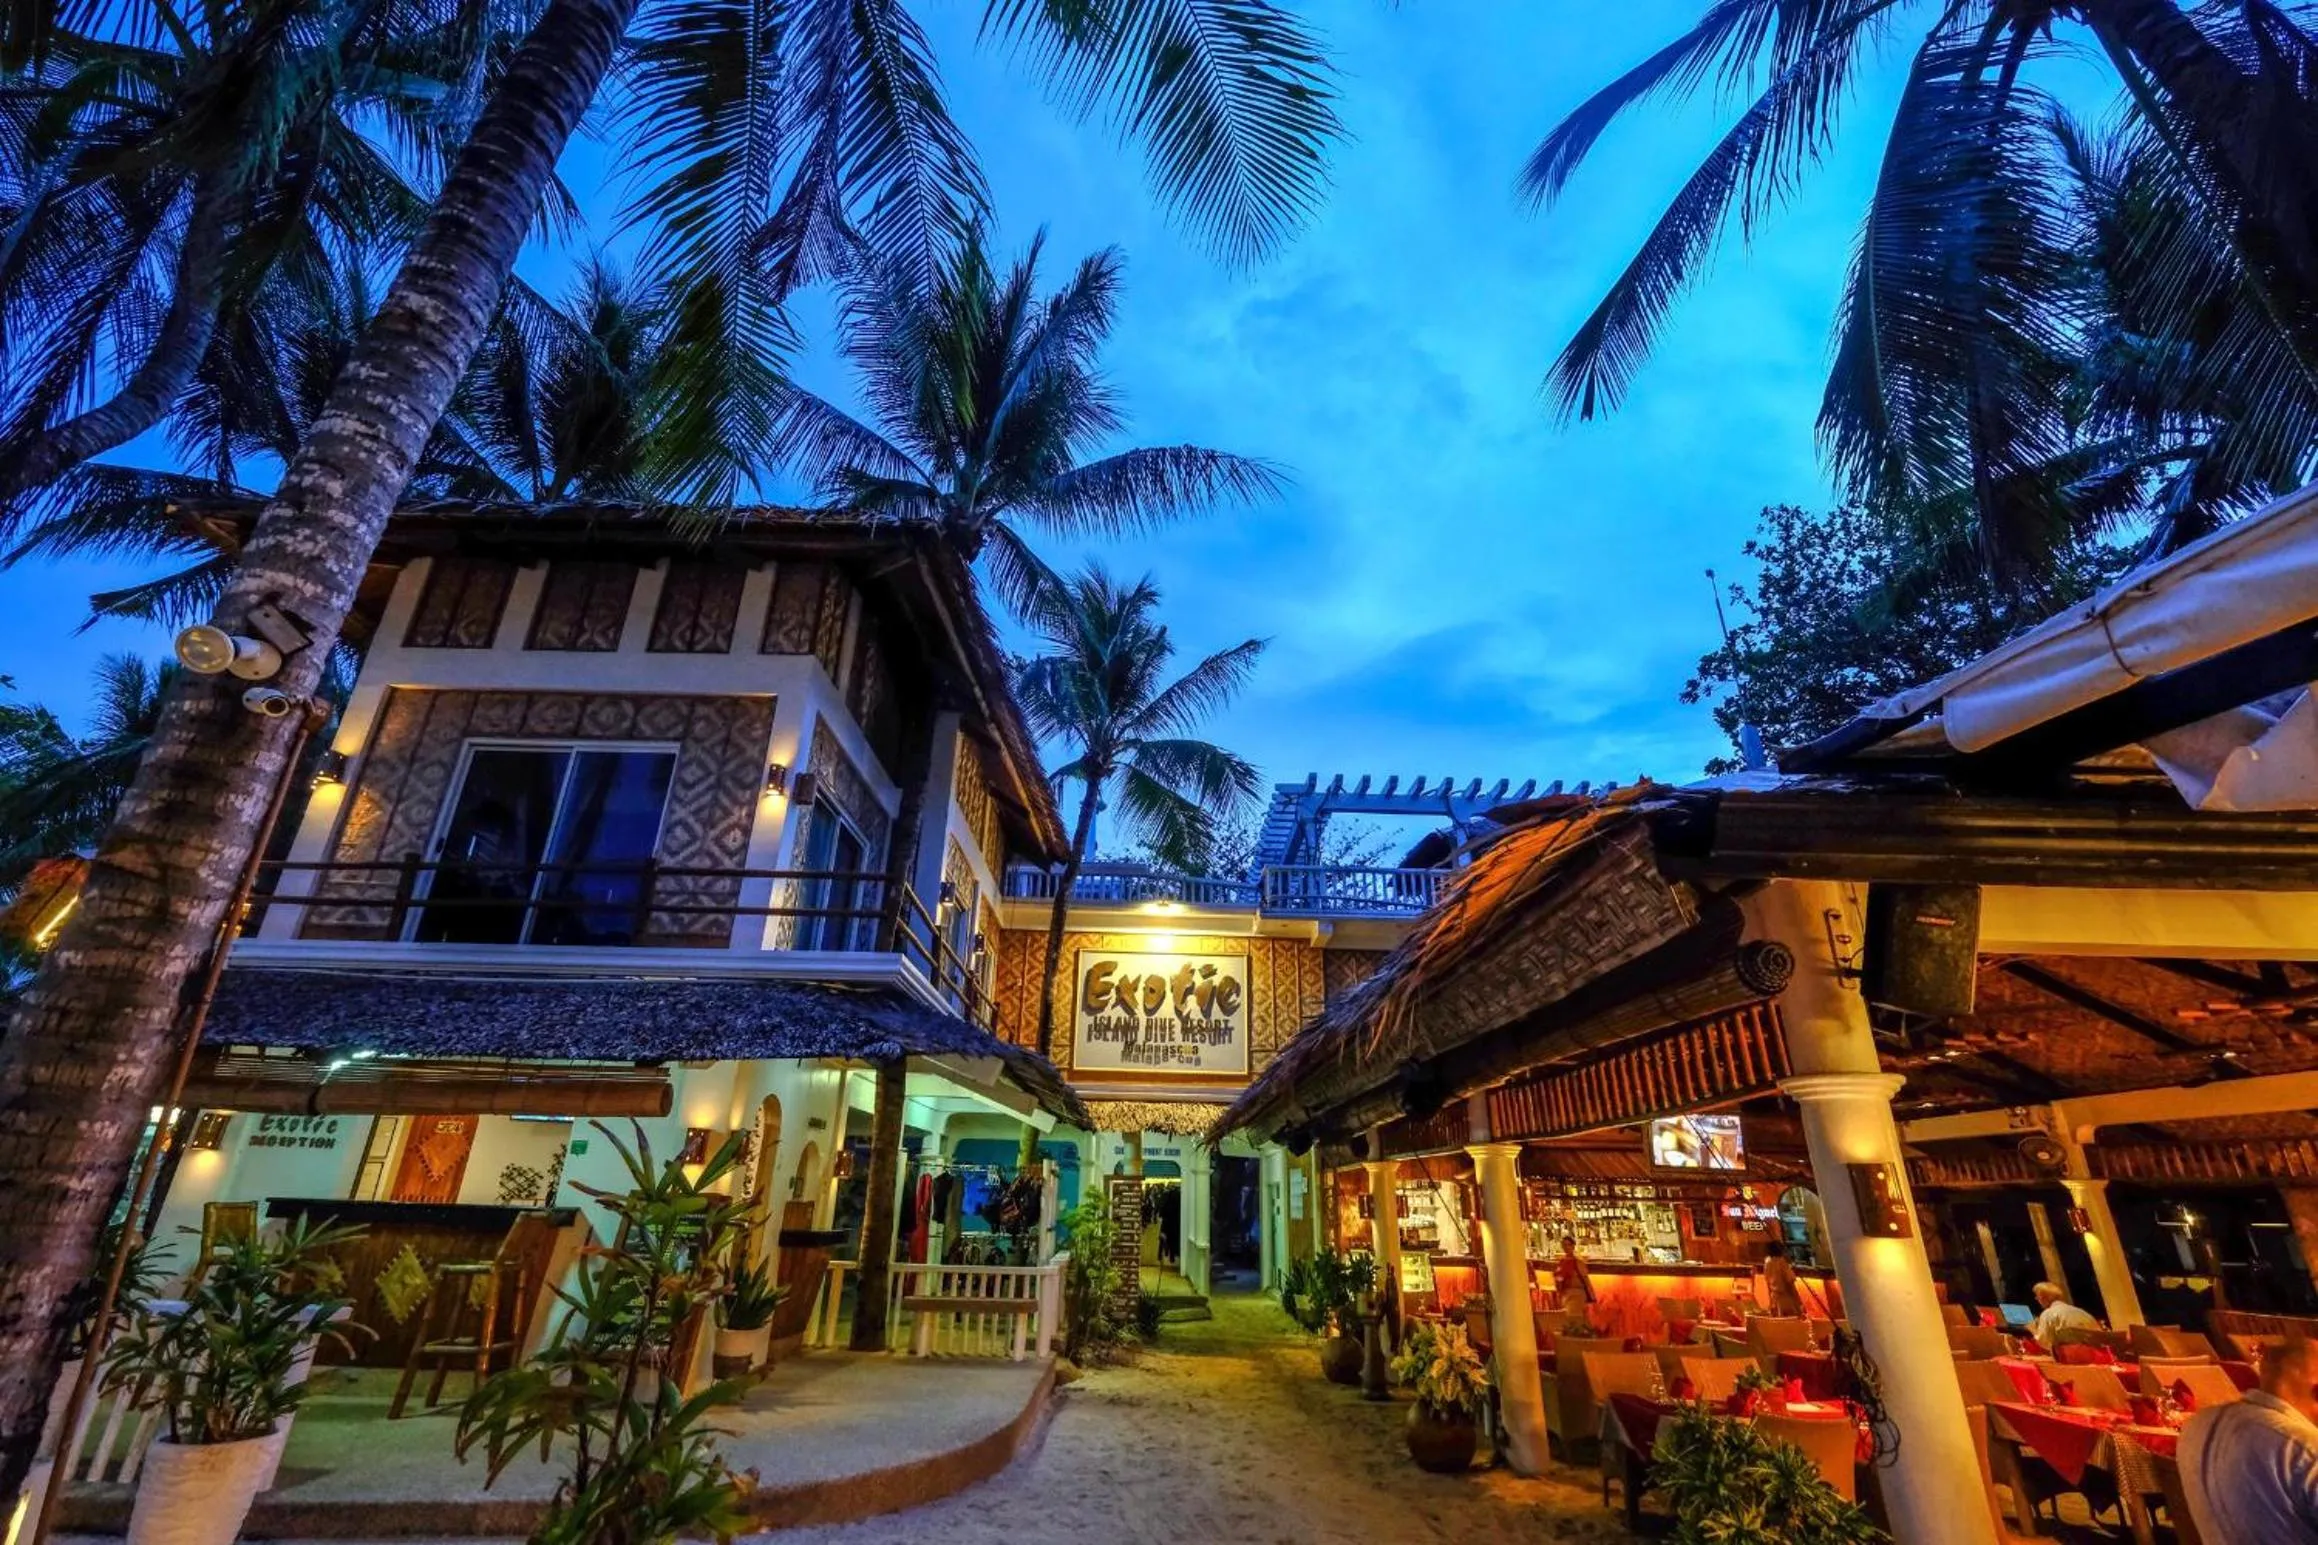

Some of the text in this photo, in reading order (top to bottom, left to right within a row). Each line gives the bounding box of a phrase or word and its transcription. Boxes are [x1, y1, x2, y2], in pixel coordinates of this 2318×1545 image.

[1088, 1016, 1235, 1043] ISLAND DIVE RESORT
